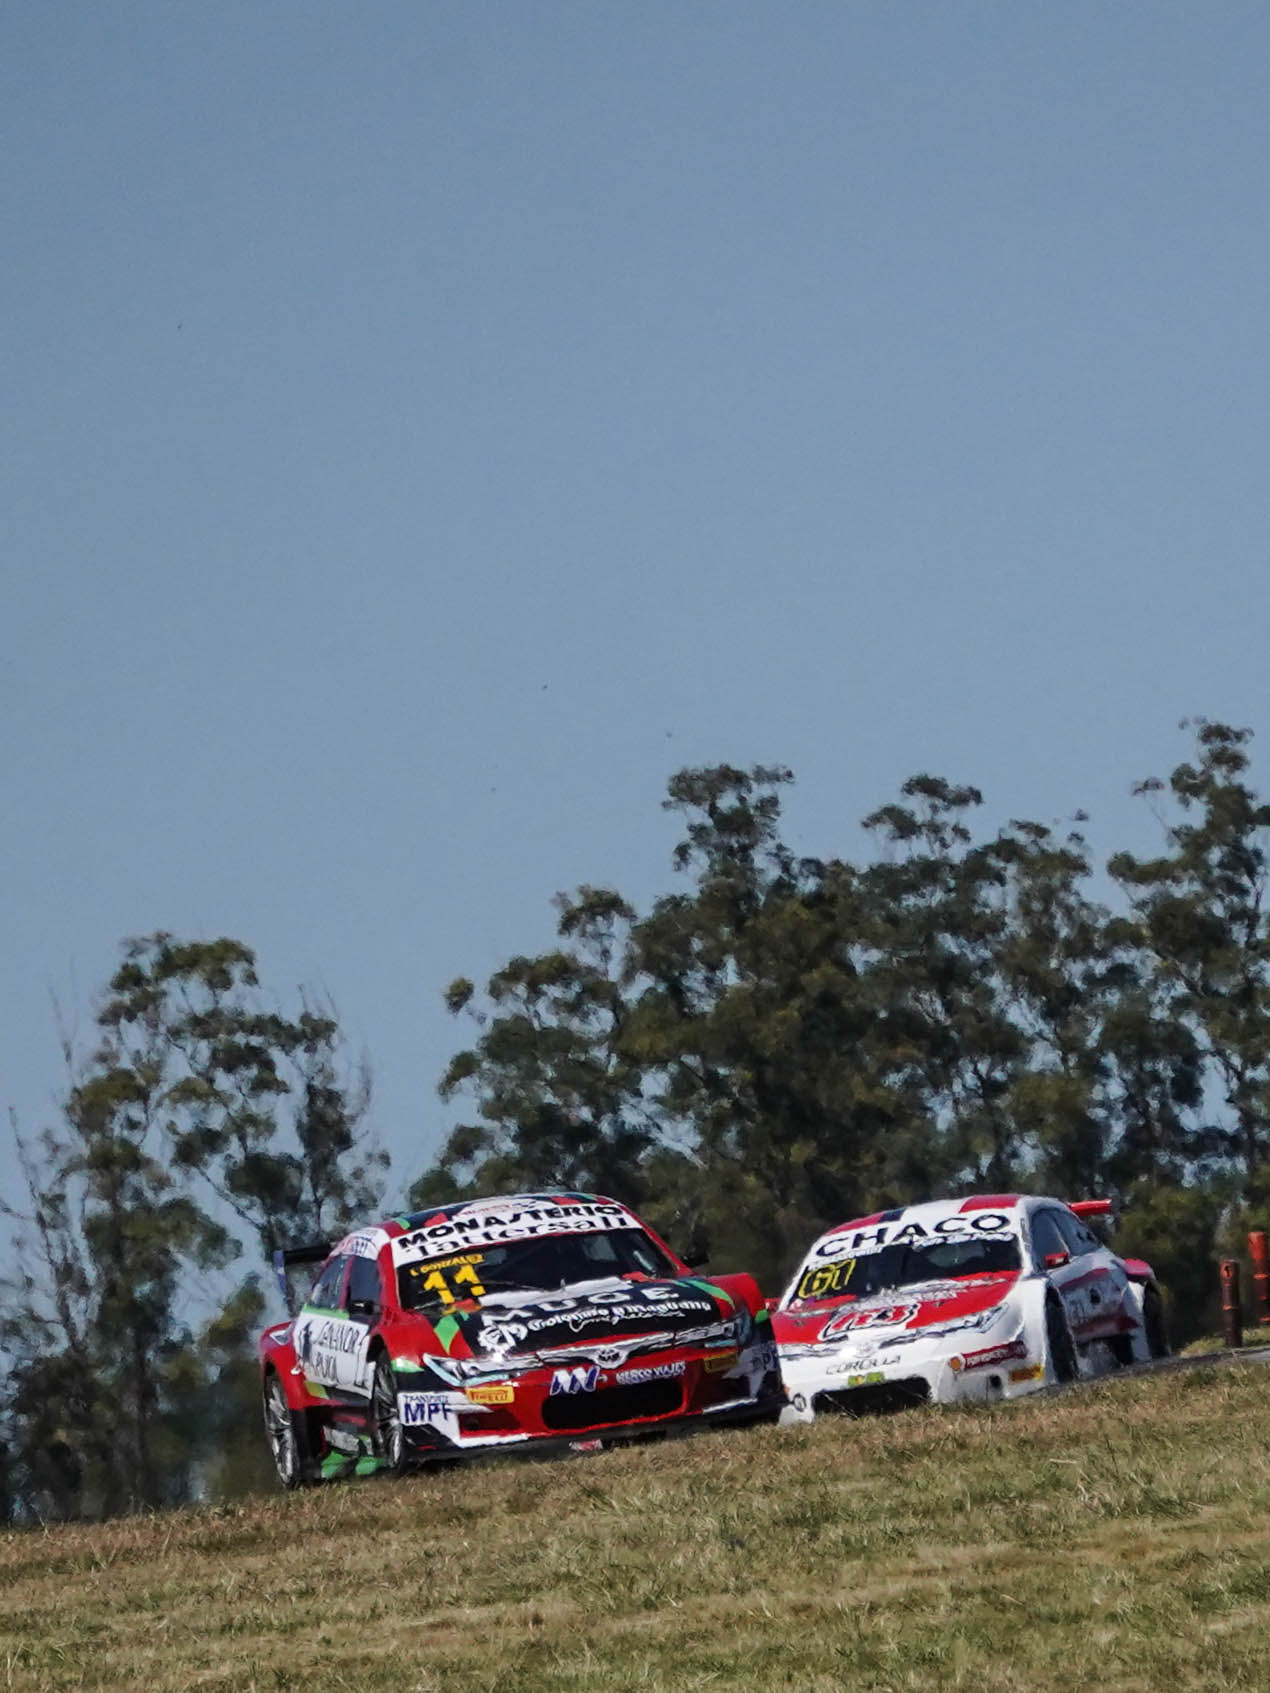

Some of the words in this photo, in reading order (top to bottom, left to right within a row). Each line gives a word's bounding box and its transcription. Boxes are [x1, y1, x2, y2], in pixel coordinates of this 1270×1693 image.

[398, 1204, 624, 1250] MONASTERIO
[815, 1213, 1010, 1257] CHACO
[423, 1264, 487, 1304] 11
[404, 1402, 453, 1424] MPF
